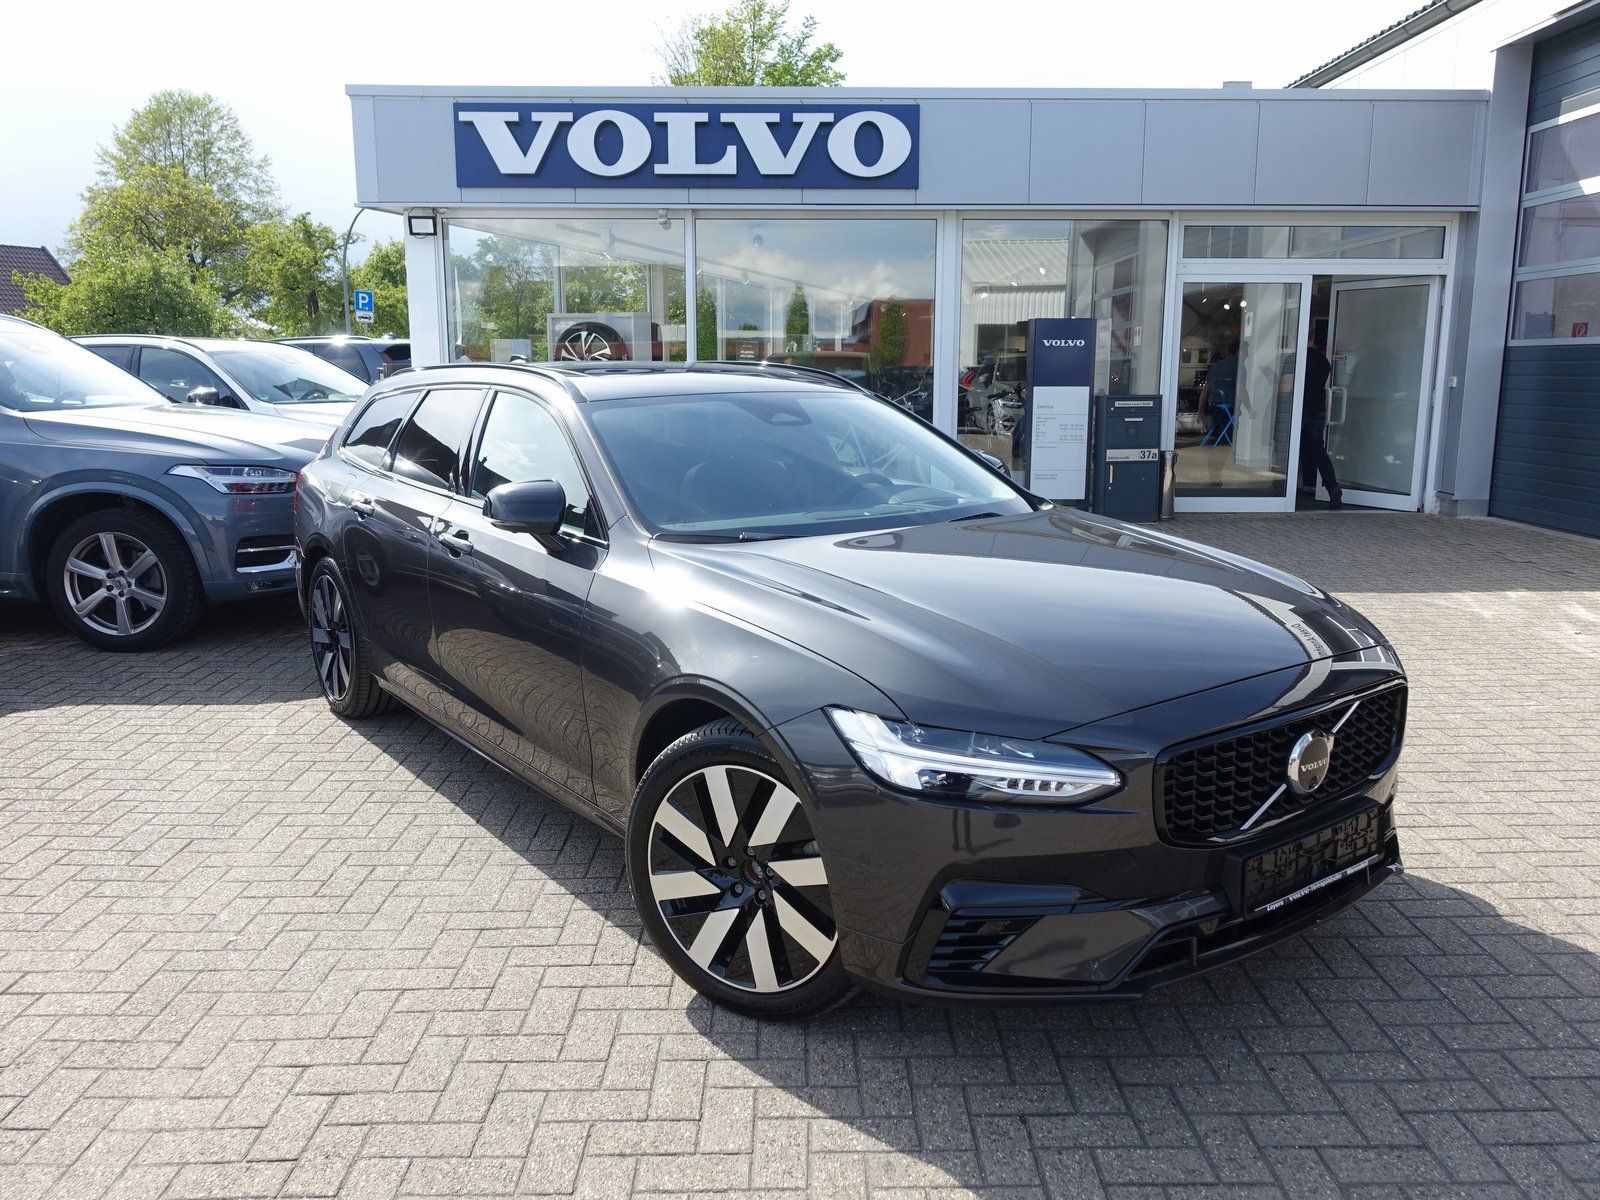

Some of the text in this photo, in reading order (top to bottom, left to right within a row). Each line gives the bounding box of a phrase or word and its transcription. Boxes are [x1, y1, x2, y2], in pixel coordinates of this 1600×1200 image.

[458, 109, 912, 178] VOLVO
[358, 292, 369, 309] P
[1042, 339, 1085, 347] VOLVO
[1140, 450, 1157, 459] 37a
